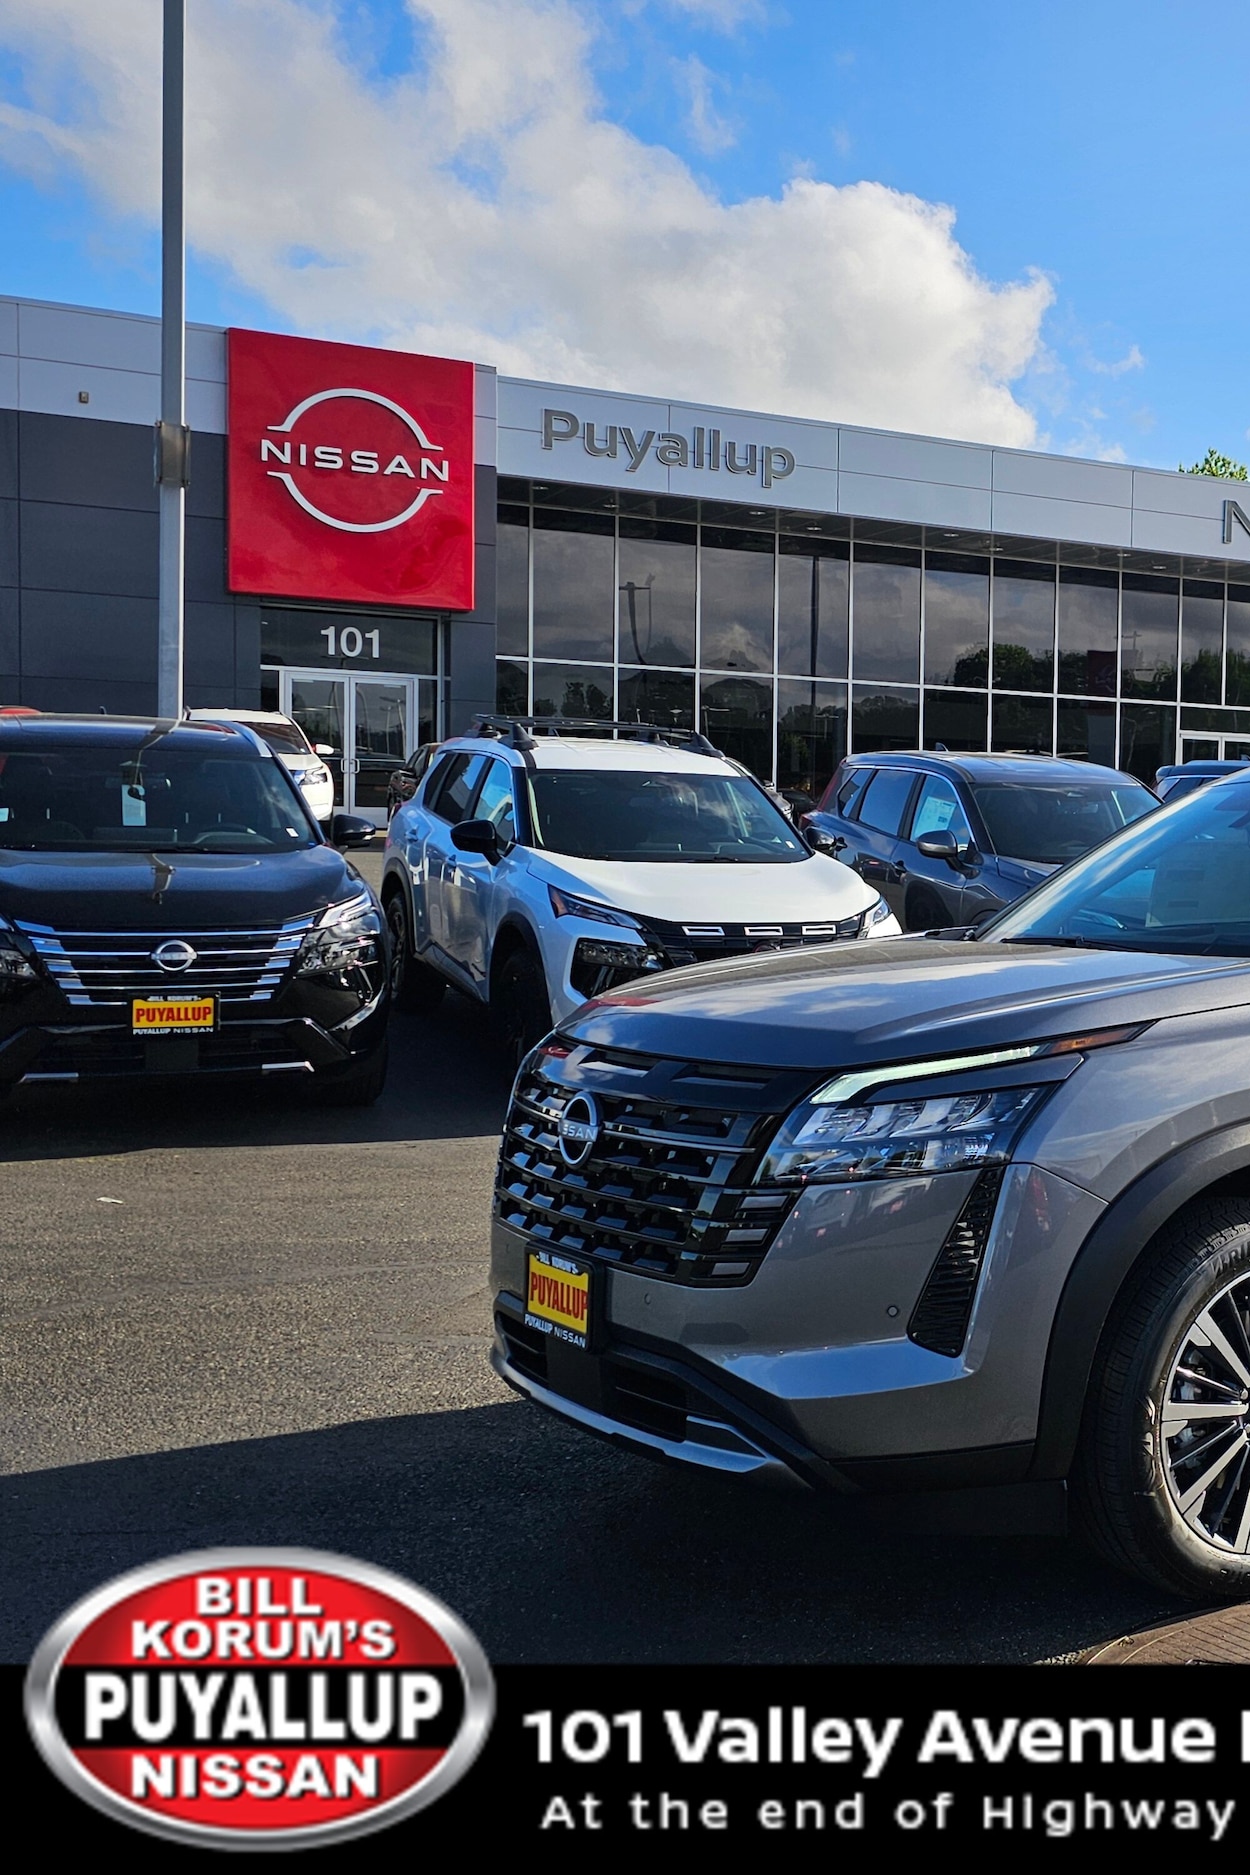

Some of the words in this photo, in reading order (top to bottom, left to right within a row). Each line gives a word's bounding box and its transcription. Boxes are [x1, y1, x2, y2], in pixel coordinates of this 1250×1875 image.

[261, 439, 449, 482] NISSAN
[542, 408, 796, 488] Puyallup
[320, 625, 380, 658] 101
[135, 1006, 212, 1023] PUYALLUP
[530, 1271, 588, 1321] PUYALLUP
[554, 1326, 586, 1349] NISSAN
